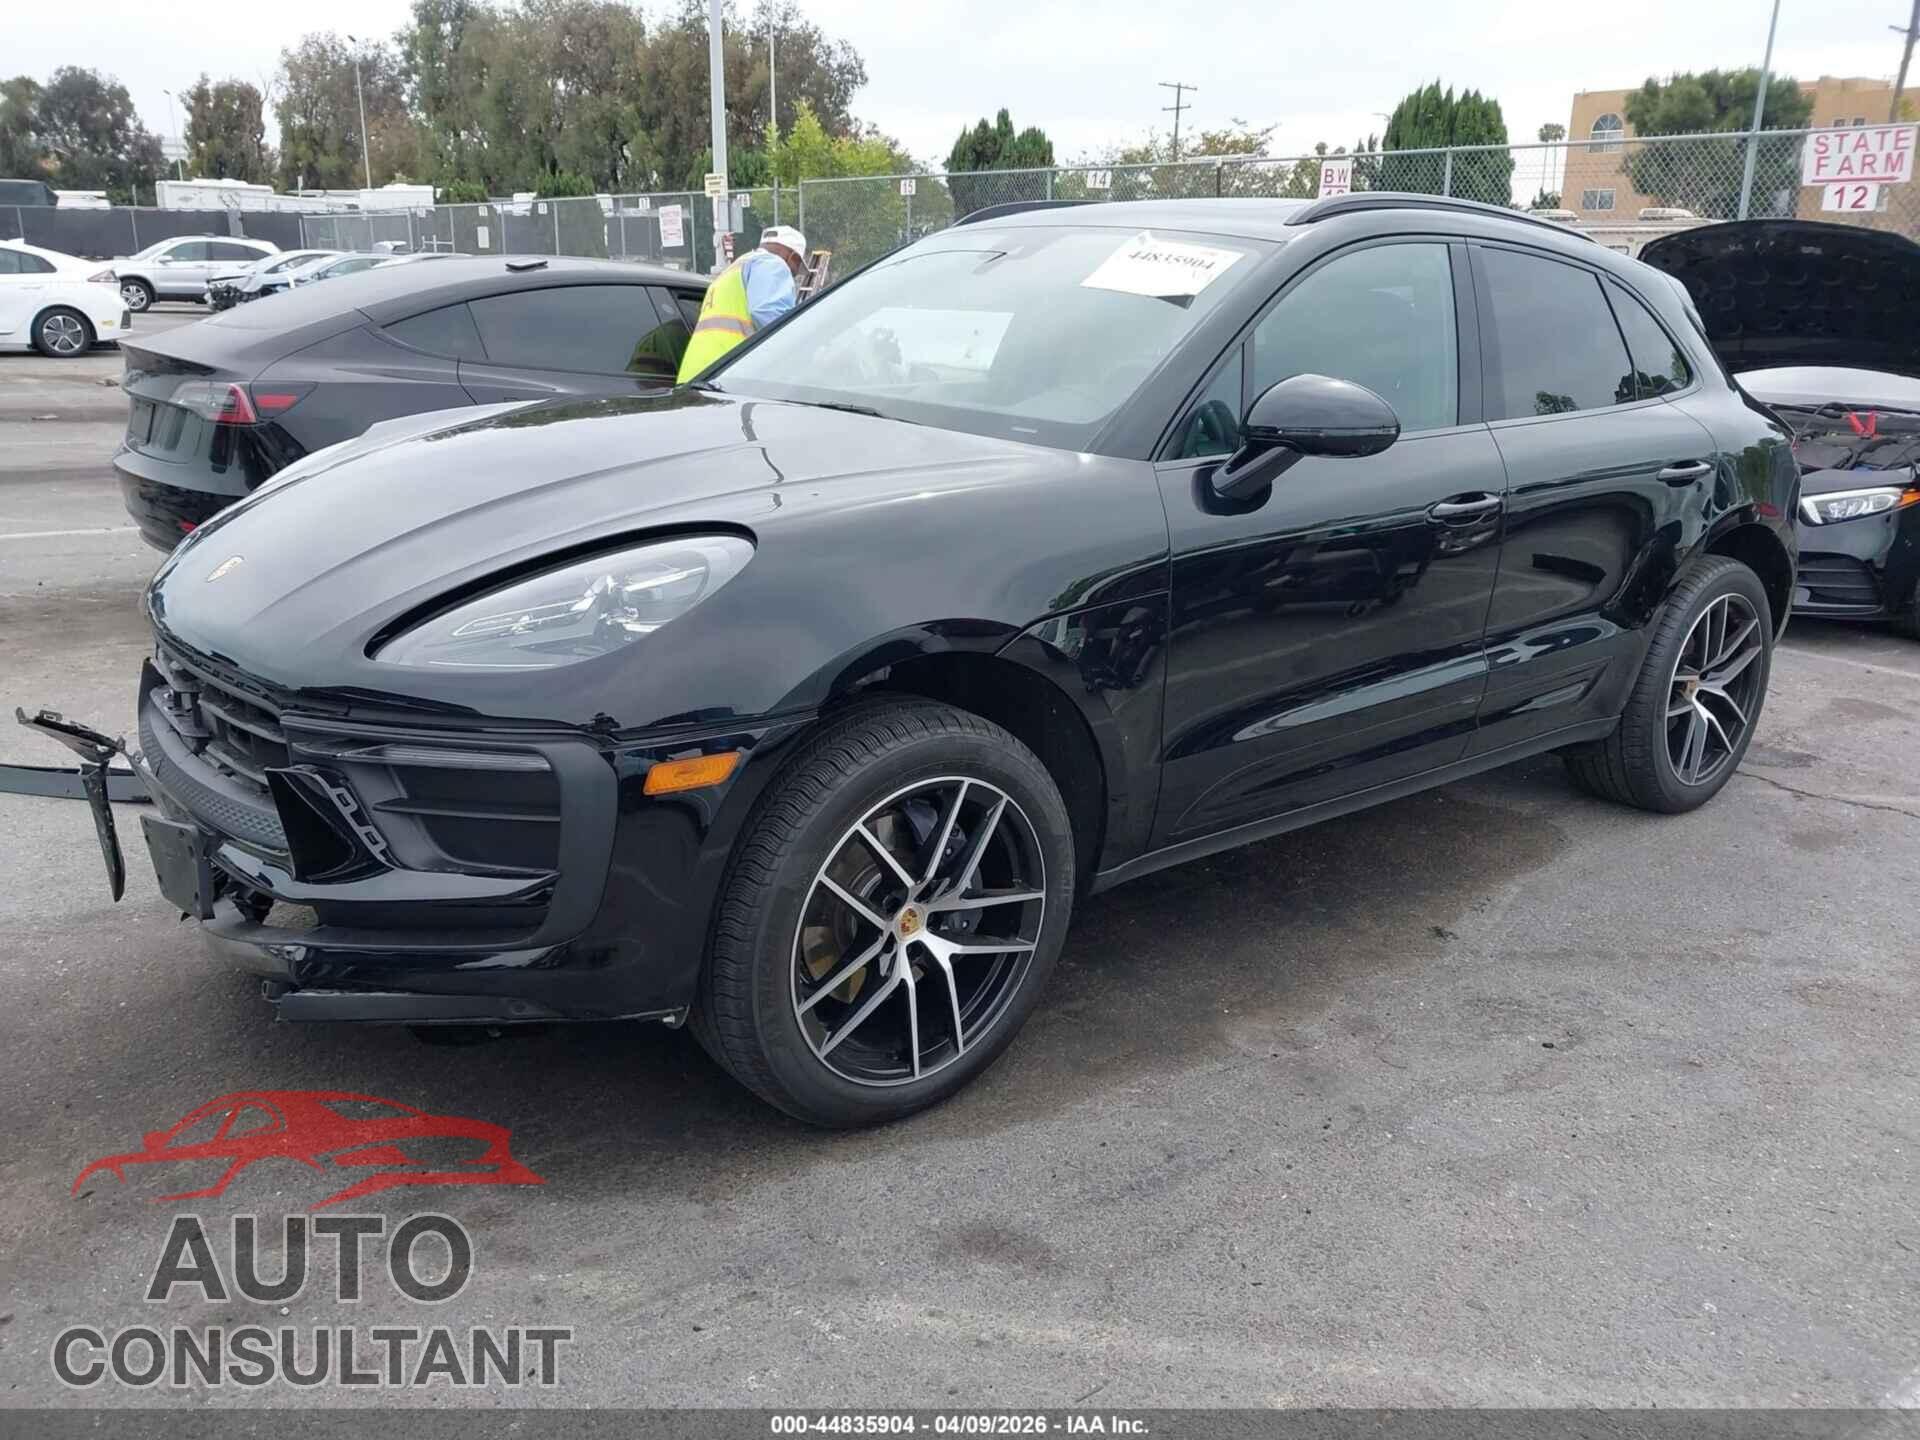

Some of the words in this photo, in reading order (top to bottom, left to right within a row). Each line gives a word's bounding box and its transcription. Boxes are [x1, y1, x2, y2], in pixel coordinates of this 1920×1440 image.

[1814, 129, 1912, 154] STATE
[1815, 151, 1904, 176] FARM
[902, 180, 913, 194] 15
[1091, 172, 1106, 187] 14
[1834, 186, 1868, 209] 12
